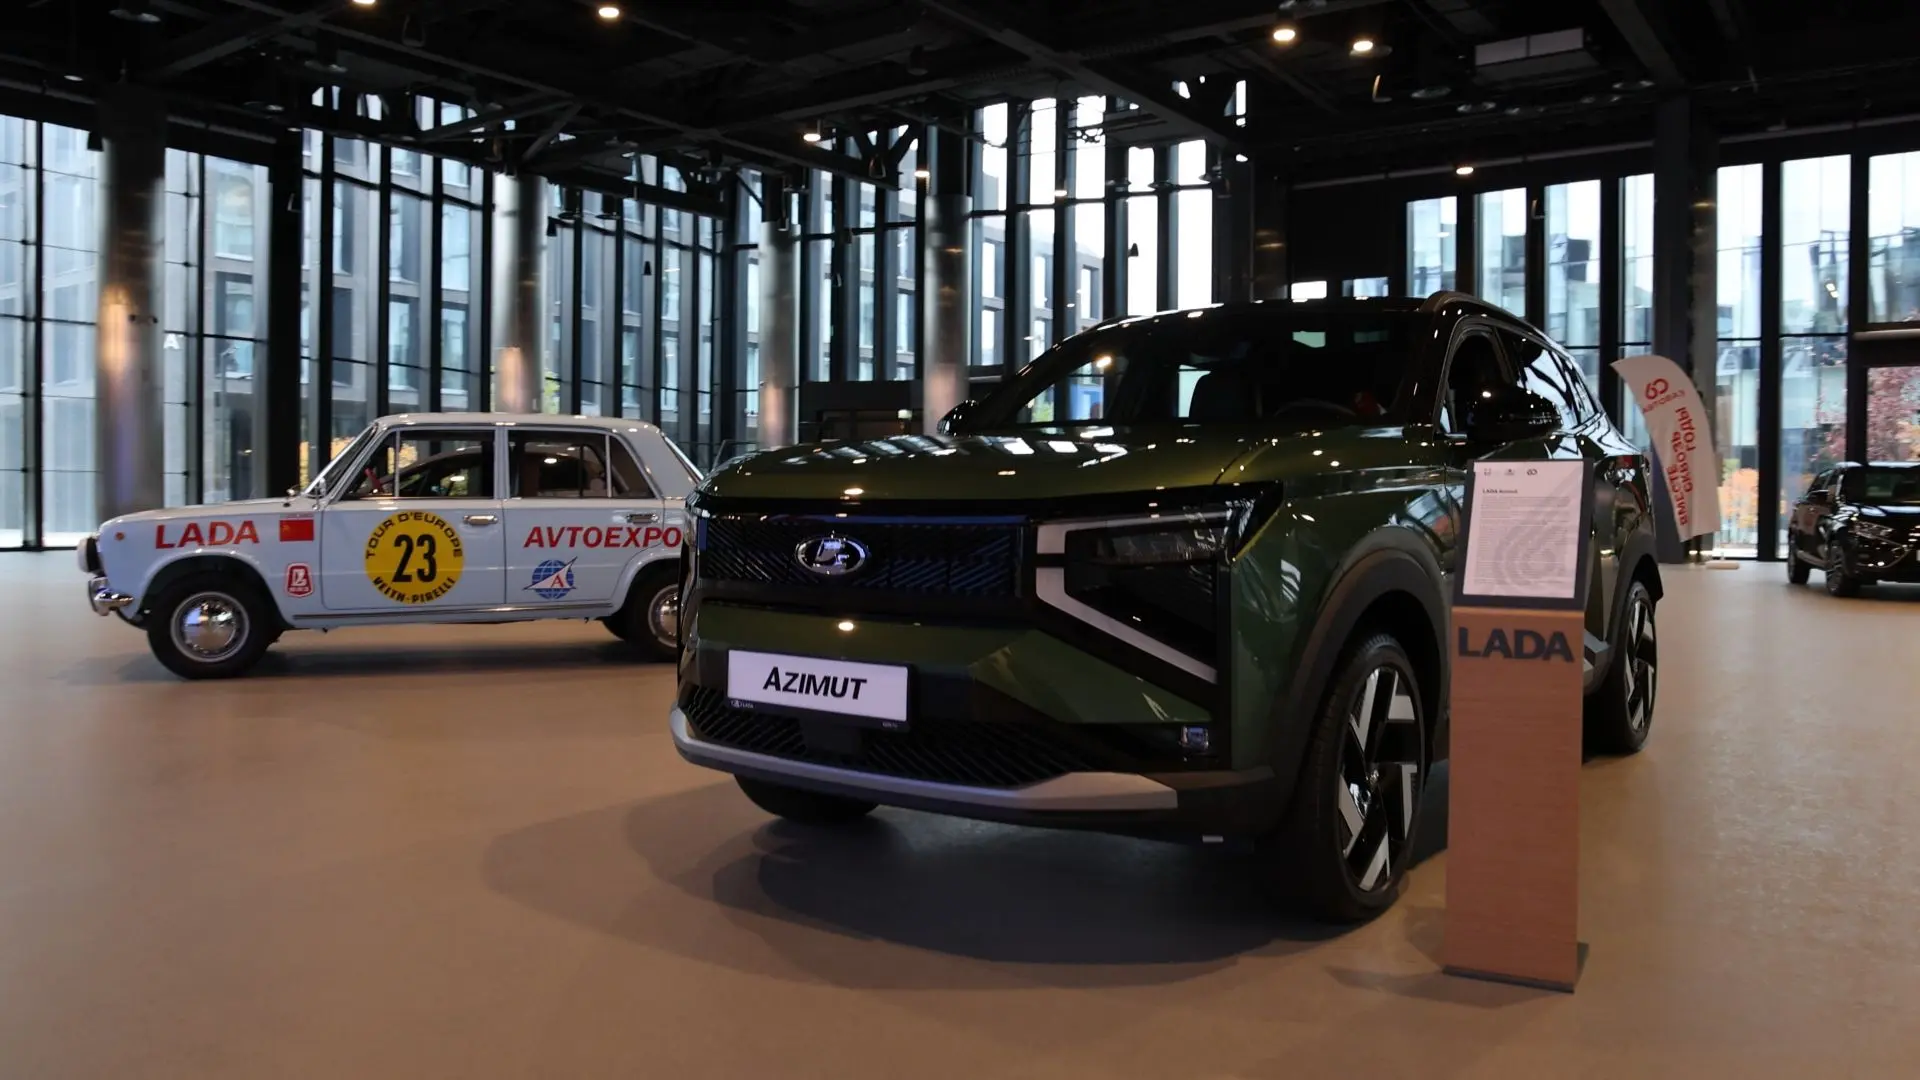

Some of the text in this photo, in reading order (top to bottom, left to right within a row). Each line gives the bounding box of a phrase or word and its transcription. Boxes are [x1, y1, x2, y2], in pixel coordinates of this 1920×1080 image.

[1675, 406, 1697, 451] ГОДЫ
[1671, 431, 1693, 493] СКВОЗЬ
[1667, 463, 1689, 526] ВМЕСТЕ
[155, 520, 260, 549] LADA
[365, 512, 463, 560] TOUR D'EUROPE
[523, 526, 682, 549] AVTOEXPO
[392, 533, 437, 583] 23
[1458, 626, 1575, 663] LADA
[763, 666, 867, 700] AZIMUT
